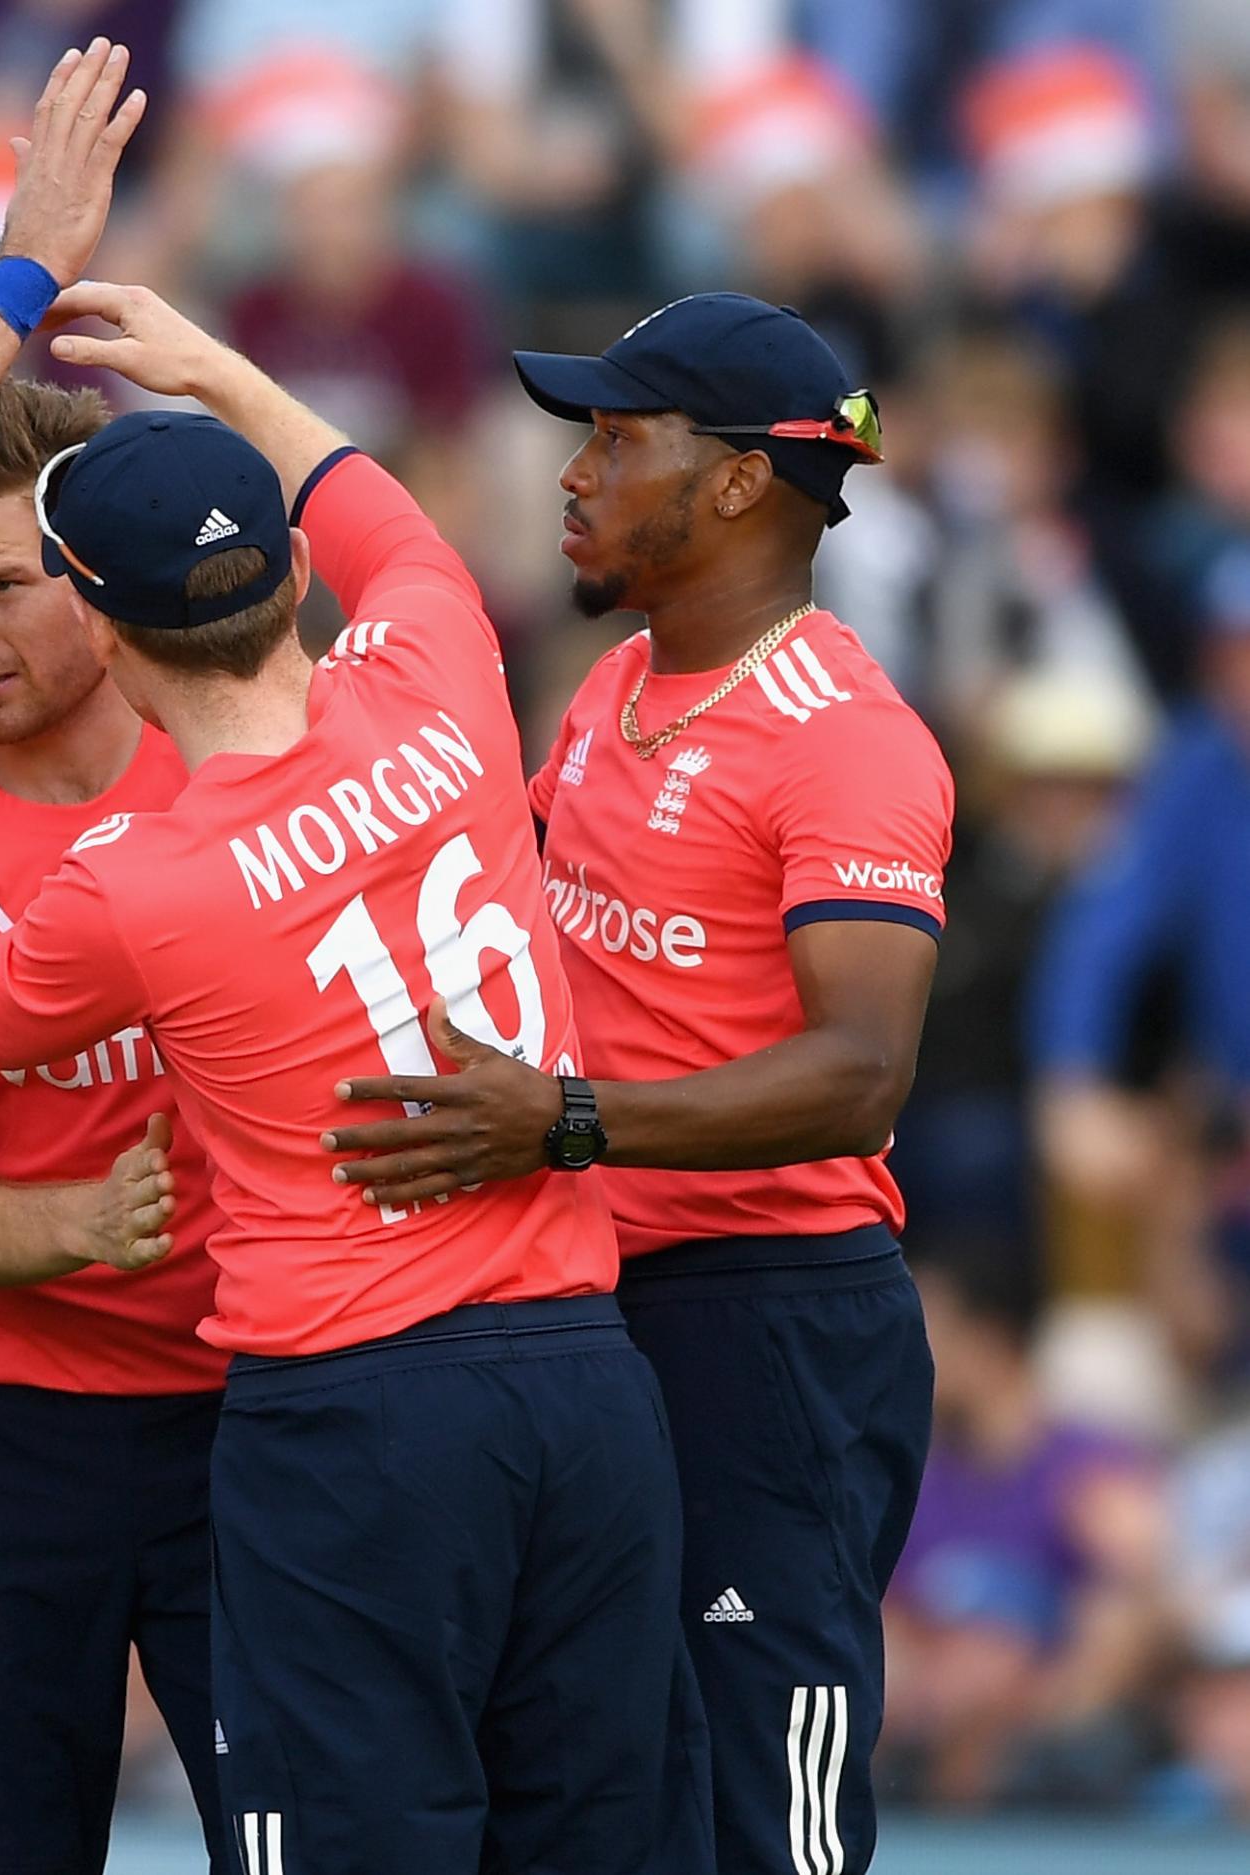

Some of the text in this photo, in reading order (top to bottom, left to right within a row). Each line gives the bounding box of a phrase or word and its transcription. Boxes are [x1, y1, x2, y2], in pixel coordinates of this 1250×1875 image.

[195, 523, 239, 546] adidas
[229, 711, 484, 911] MORGAN
[542, 859, 707, 968] aitrose
[831, 860, 944, 903] Waitro
[306, 833, 546, 1119] 16
[703, 1610, 755, 1622] adidas
